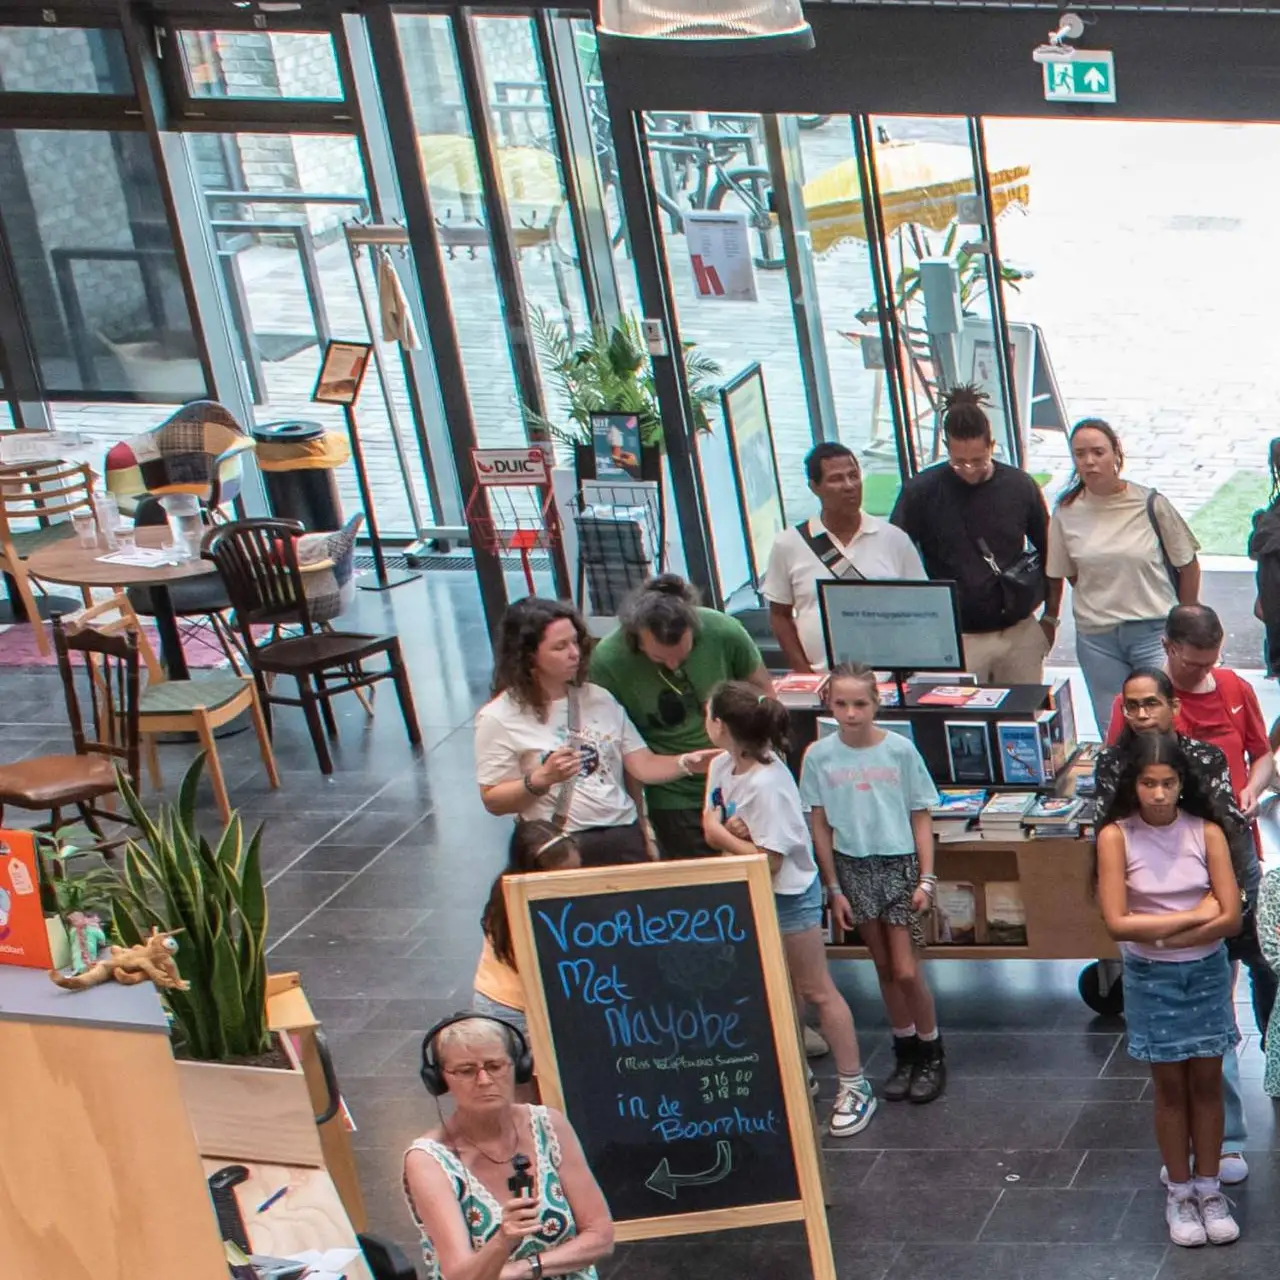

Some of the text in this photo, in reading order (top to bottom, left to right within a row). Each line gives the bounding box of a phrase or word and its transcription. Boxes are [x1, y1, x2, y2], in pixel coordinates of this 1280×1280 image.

[495, 459, 536, 473] DUIC
[557, 958, 636, 1004] Met
[605, 996, 750, 1060] Nayobé
[616, 1093, 683, 1119] in de
